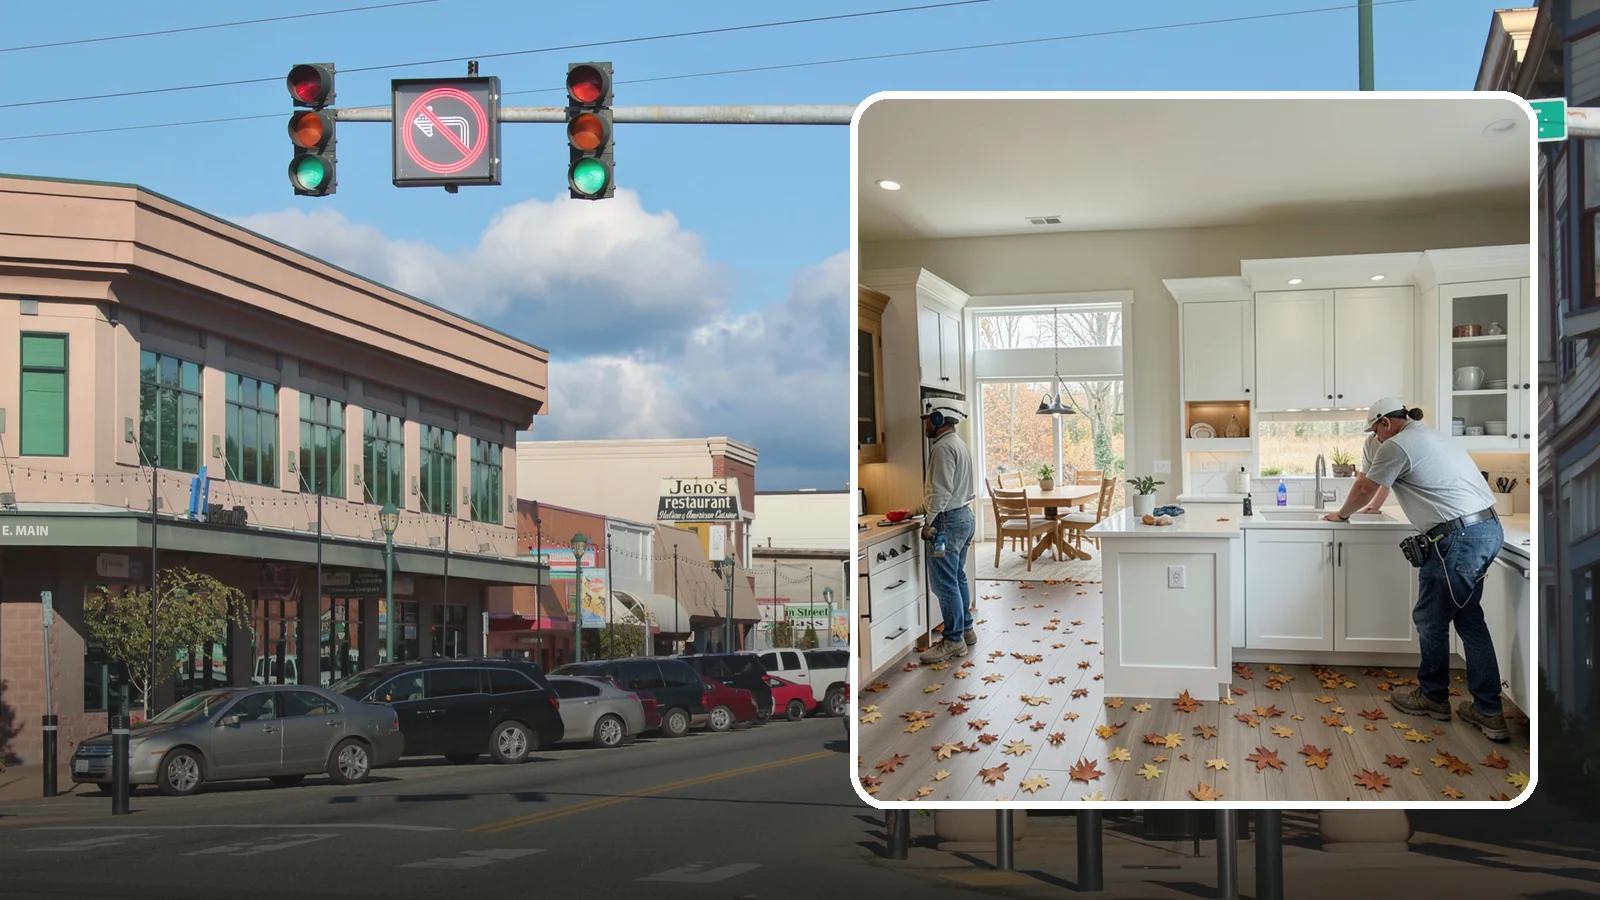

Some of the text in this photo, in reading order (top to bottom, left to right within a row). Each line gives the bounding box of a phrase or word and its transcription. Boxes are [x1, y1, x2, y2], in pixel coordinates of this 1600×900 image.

[670, 480, 727, 494] Jeno's
[665, 496, 731, 509] restaurant
[659, 510, 681, 519] Italian
[686, 510, 714, 519] American
[715, 510, 738, 519] Cuisine
[2, 525, 49, 536] E. MAIN
[797, 607, 829, 617] Street
[791, 619, 824, 627] lass
